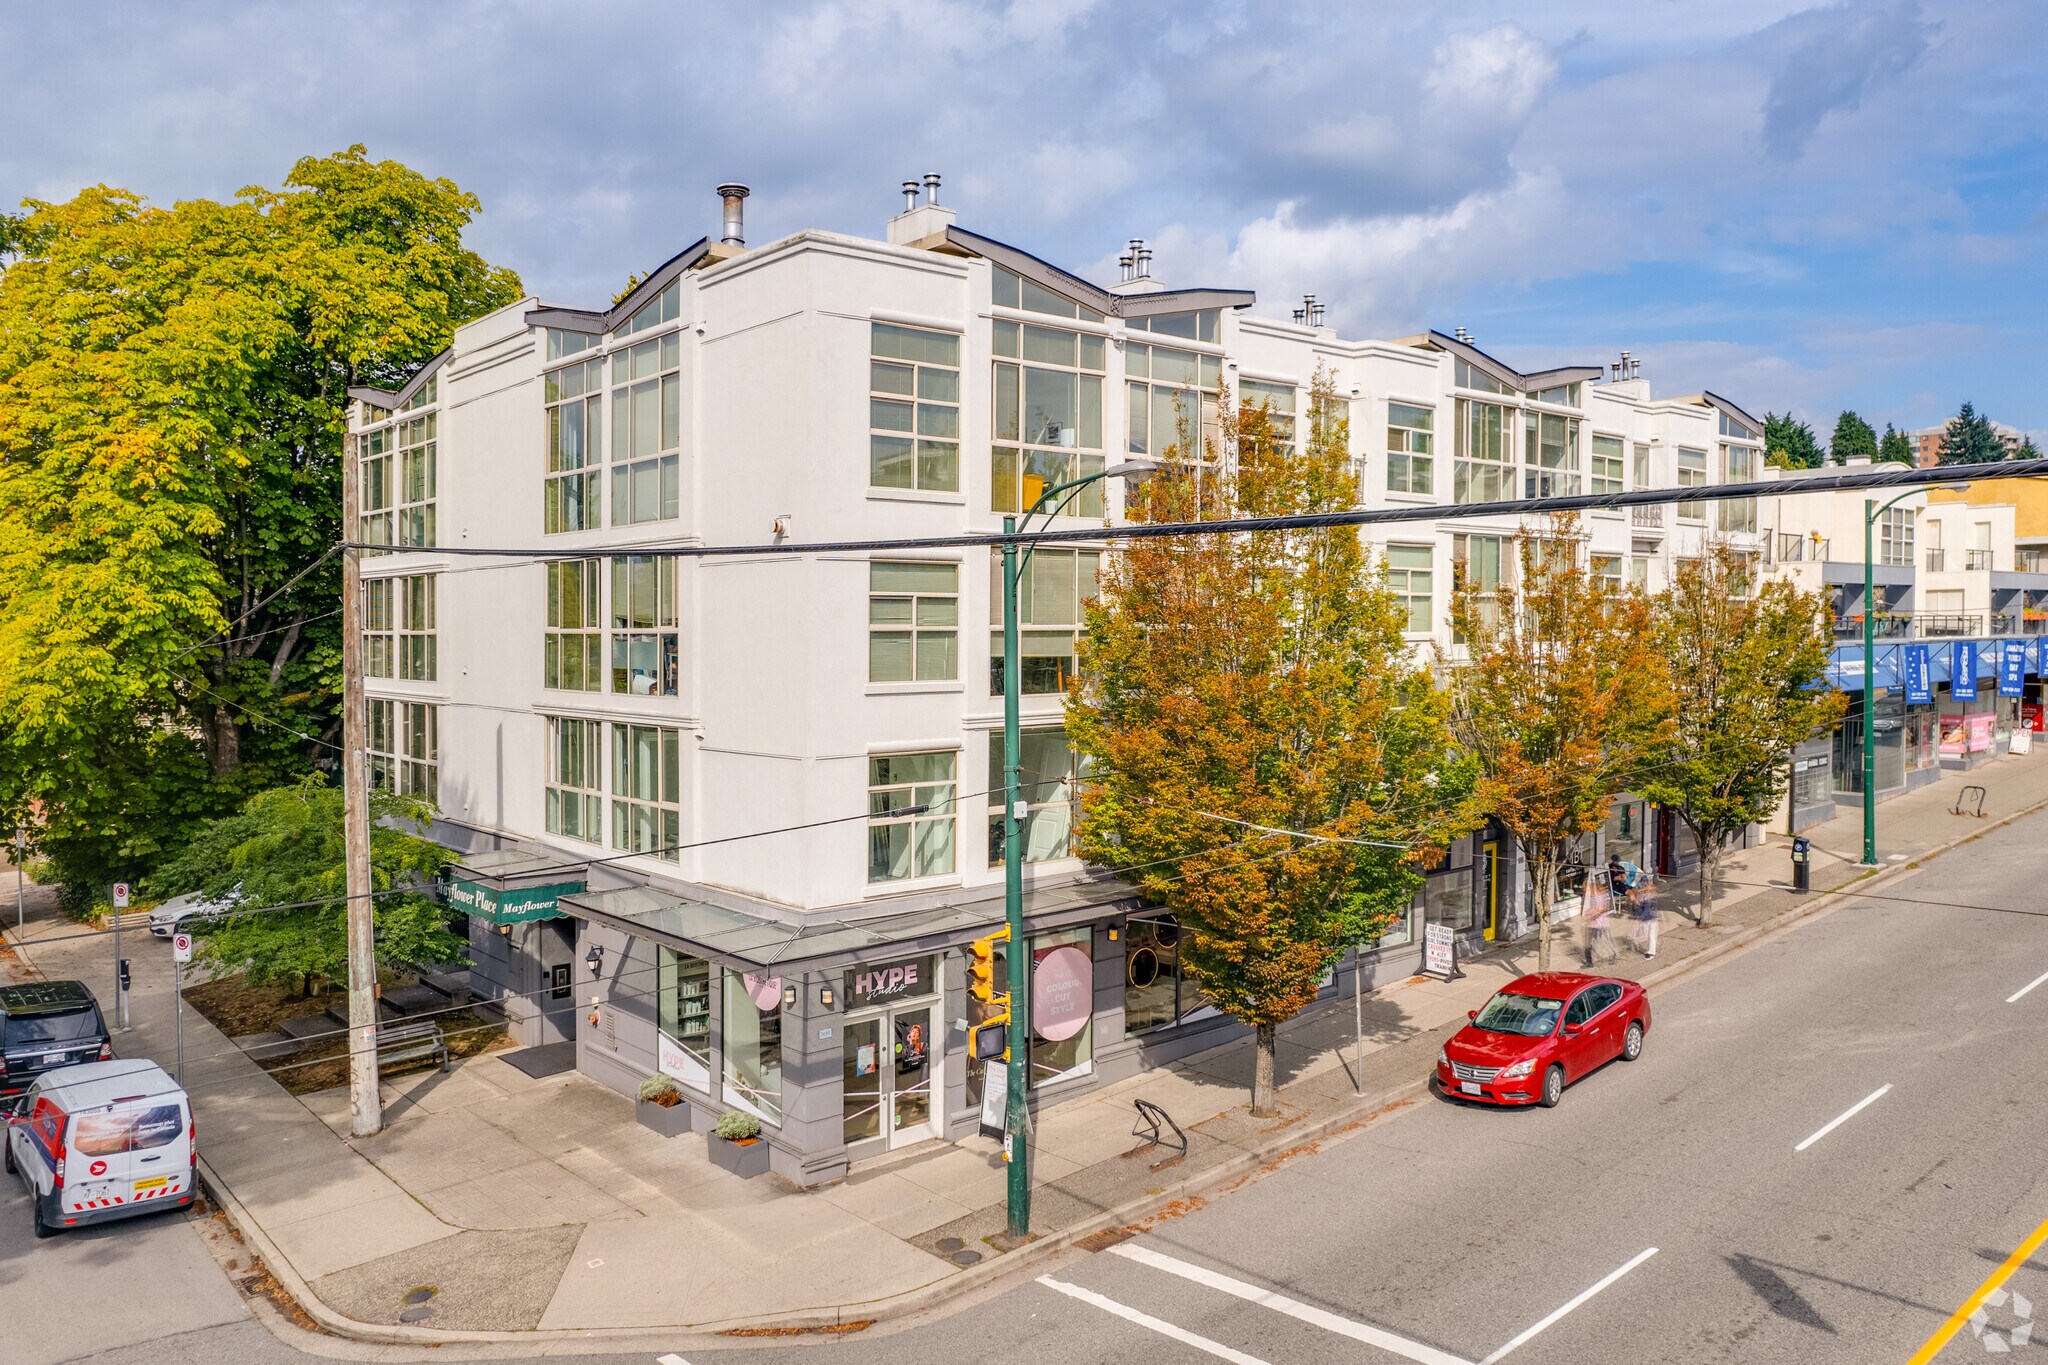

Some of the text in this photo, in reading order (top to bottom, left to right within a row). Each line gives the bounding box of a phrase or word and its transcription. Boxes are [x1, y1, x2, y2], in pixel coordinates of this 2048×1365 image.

[2012, 728, 2033, 738] OPEN
[437, 877, 497, 914] Mayflower Place
[502, 900, 555, 914] Mayflower
[855, 963, 918, 995] HYPE
[1046, 979, 1080, 993] COLOUR
[867, 983, 907, 1001] studio
[1055, 992, 1071, 1002] CUT
[1050, 1003, 1076, 1016] STYLE
[662, 1049, 685, 1069] HYPE
